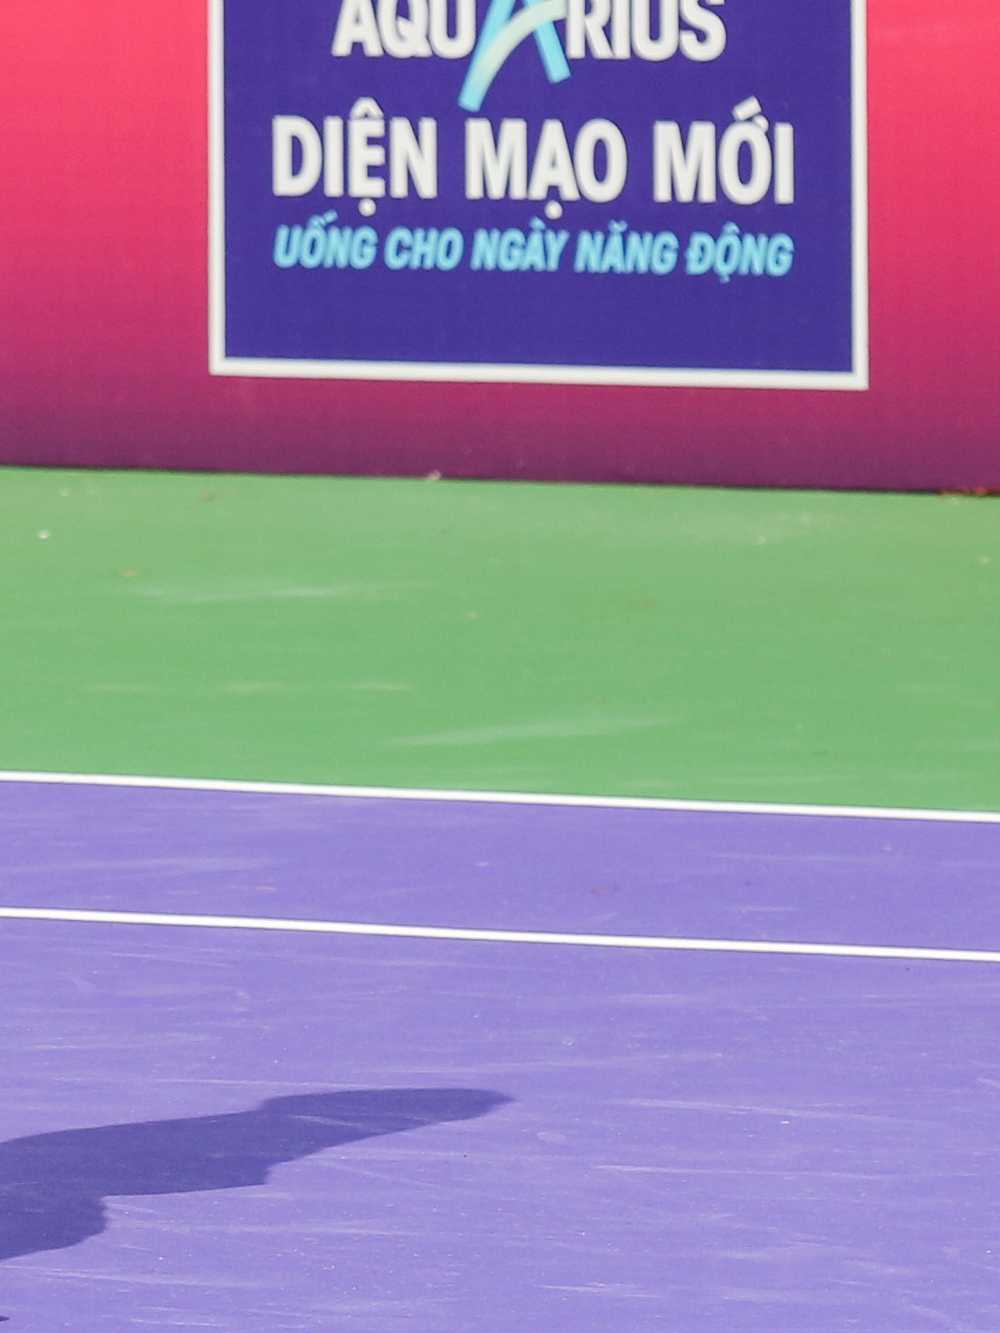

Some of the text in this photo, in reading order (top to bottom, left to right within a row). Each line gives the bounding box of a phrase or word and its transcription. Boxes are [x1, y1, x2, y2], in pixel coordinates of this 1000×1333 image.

[272, 96, 795, 220] DIỆN MẠO MỚI
[273, 209, 795, 284] UỐNG CHO NGÀY NĂNG ĐỘNG
